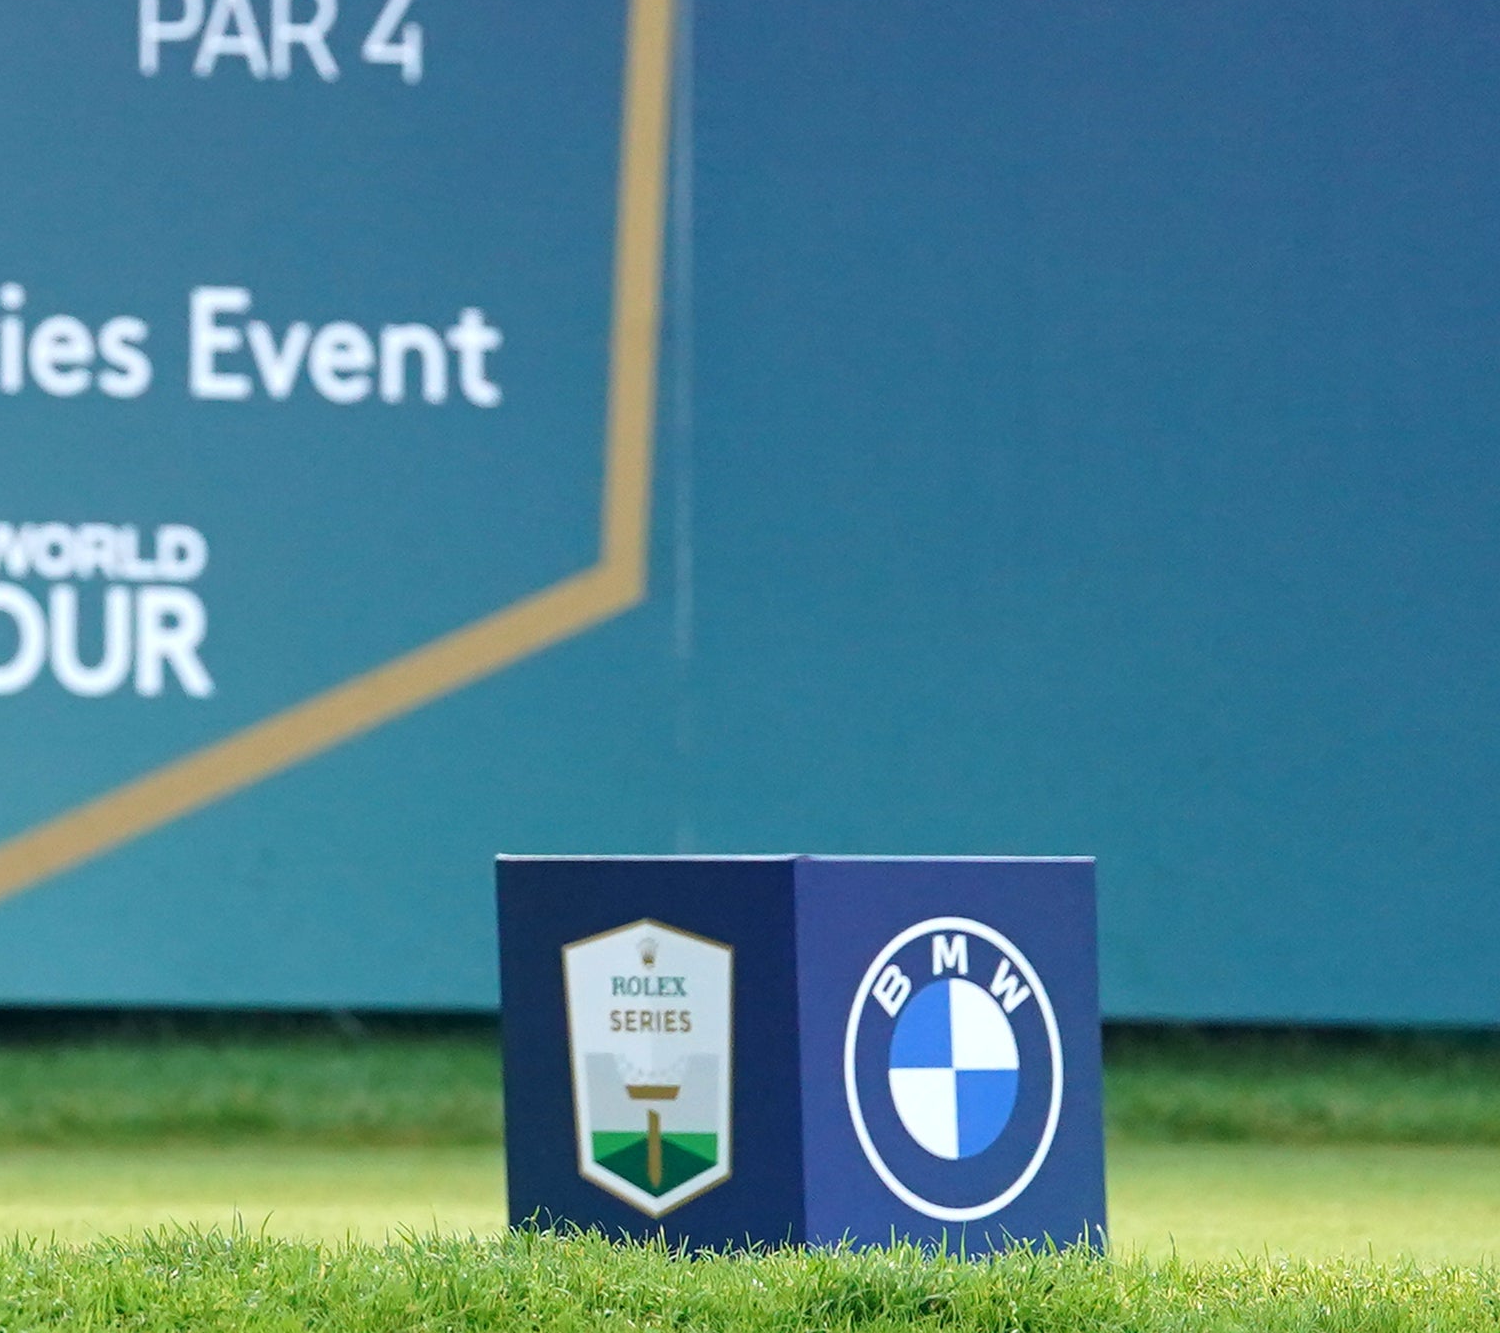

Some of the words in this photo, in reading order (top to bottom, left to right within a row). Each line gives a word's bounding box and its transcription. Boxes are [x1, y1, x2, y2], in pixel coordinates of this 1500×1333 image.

[187, 284, 503, 409] Event
[610, 975, 688, 998] ROLEX
[872, 934, 1031, 1019] BMW
[608, 1009, 692, 1034] SERIES
